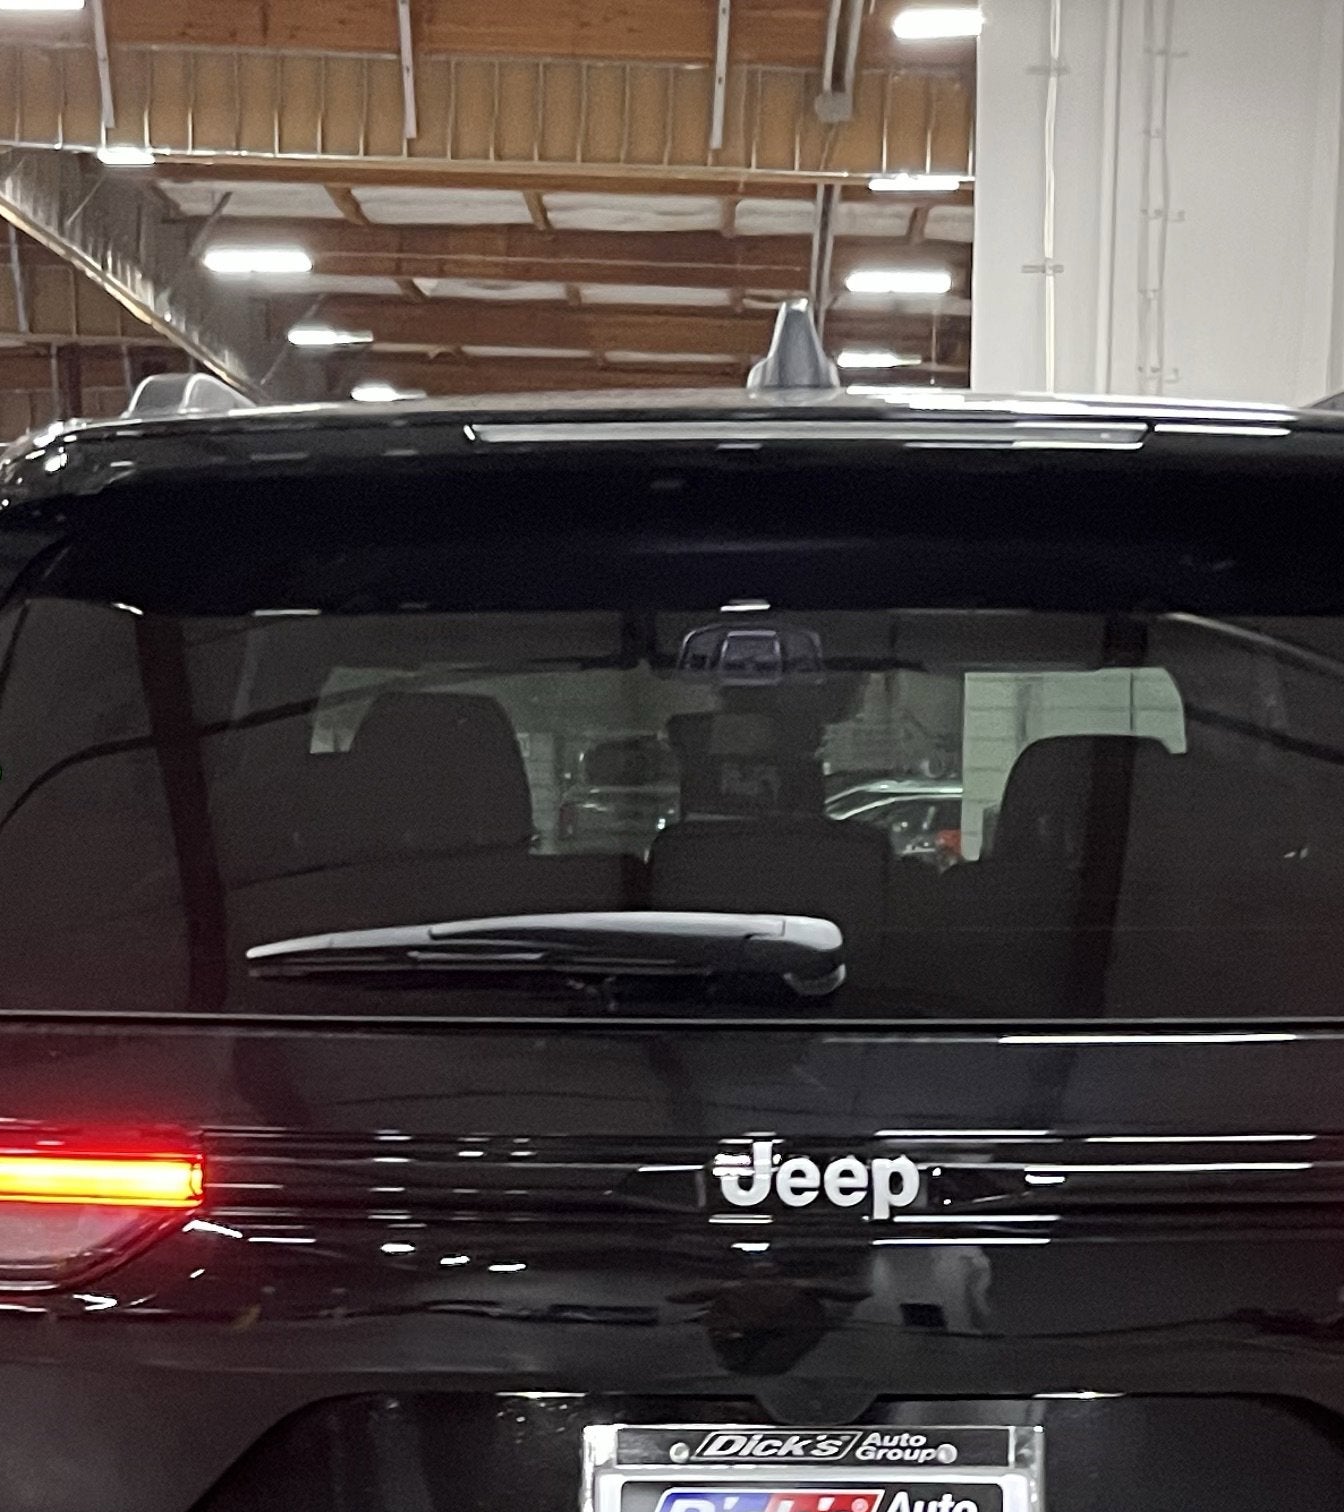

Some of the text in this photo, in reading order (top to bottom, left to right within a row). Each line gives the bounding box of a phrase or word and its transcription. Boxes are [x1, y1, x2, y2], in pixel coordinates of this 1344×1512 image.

[713, 1141, 920, 1220] Jeep
[706, 1432, 927, 1457] Dick's Auto
[855, 1447, 938, 1463] Group
